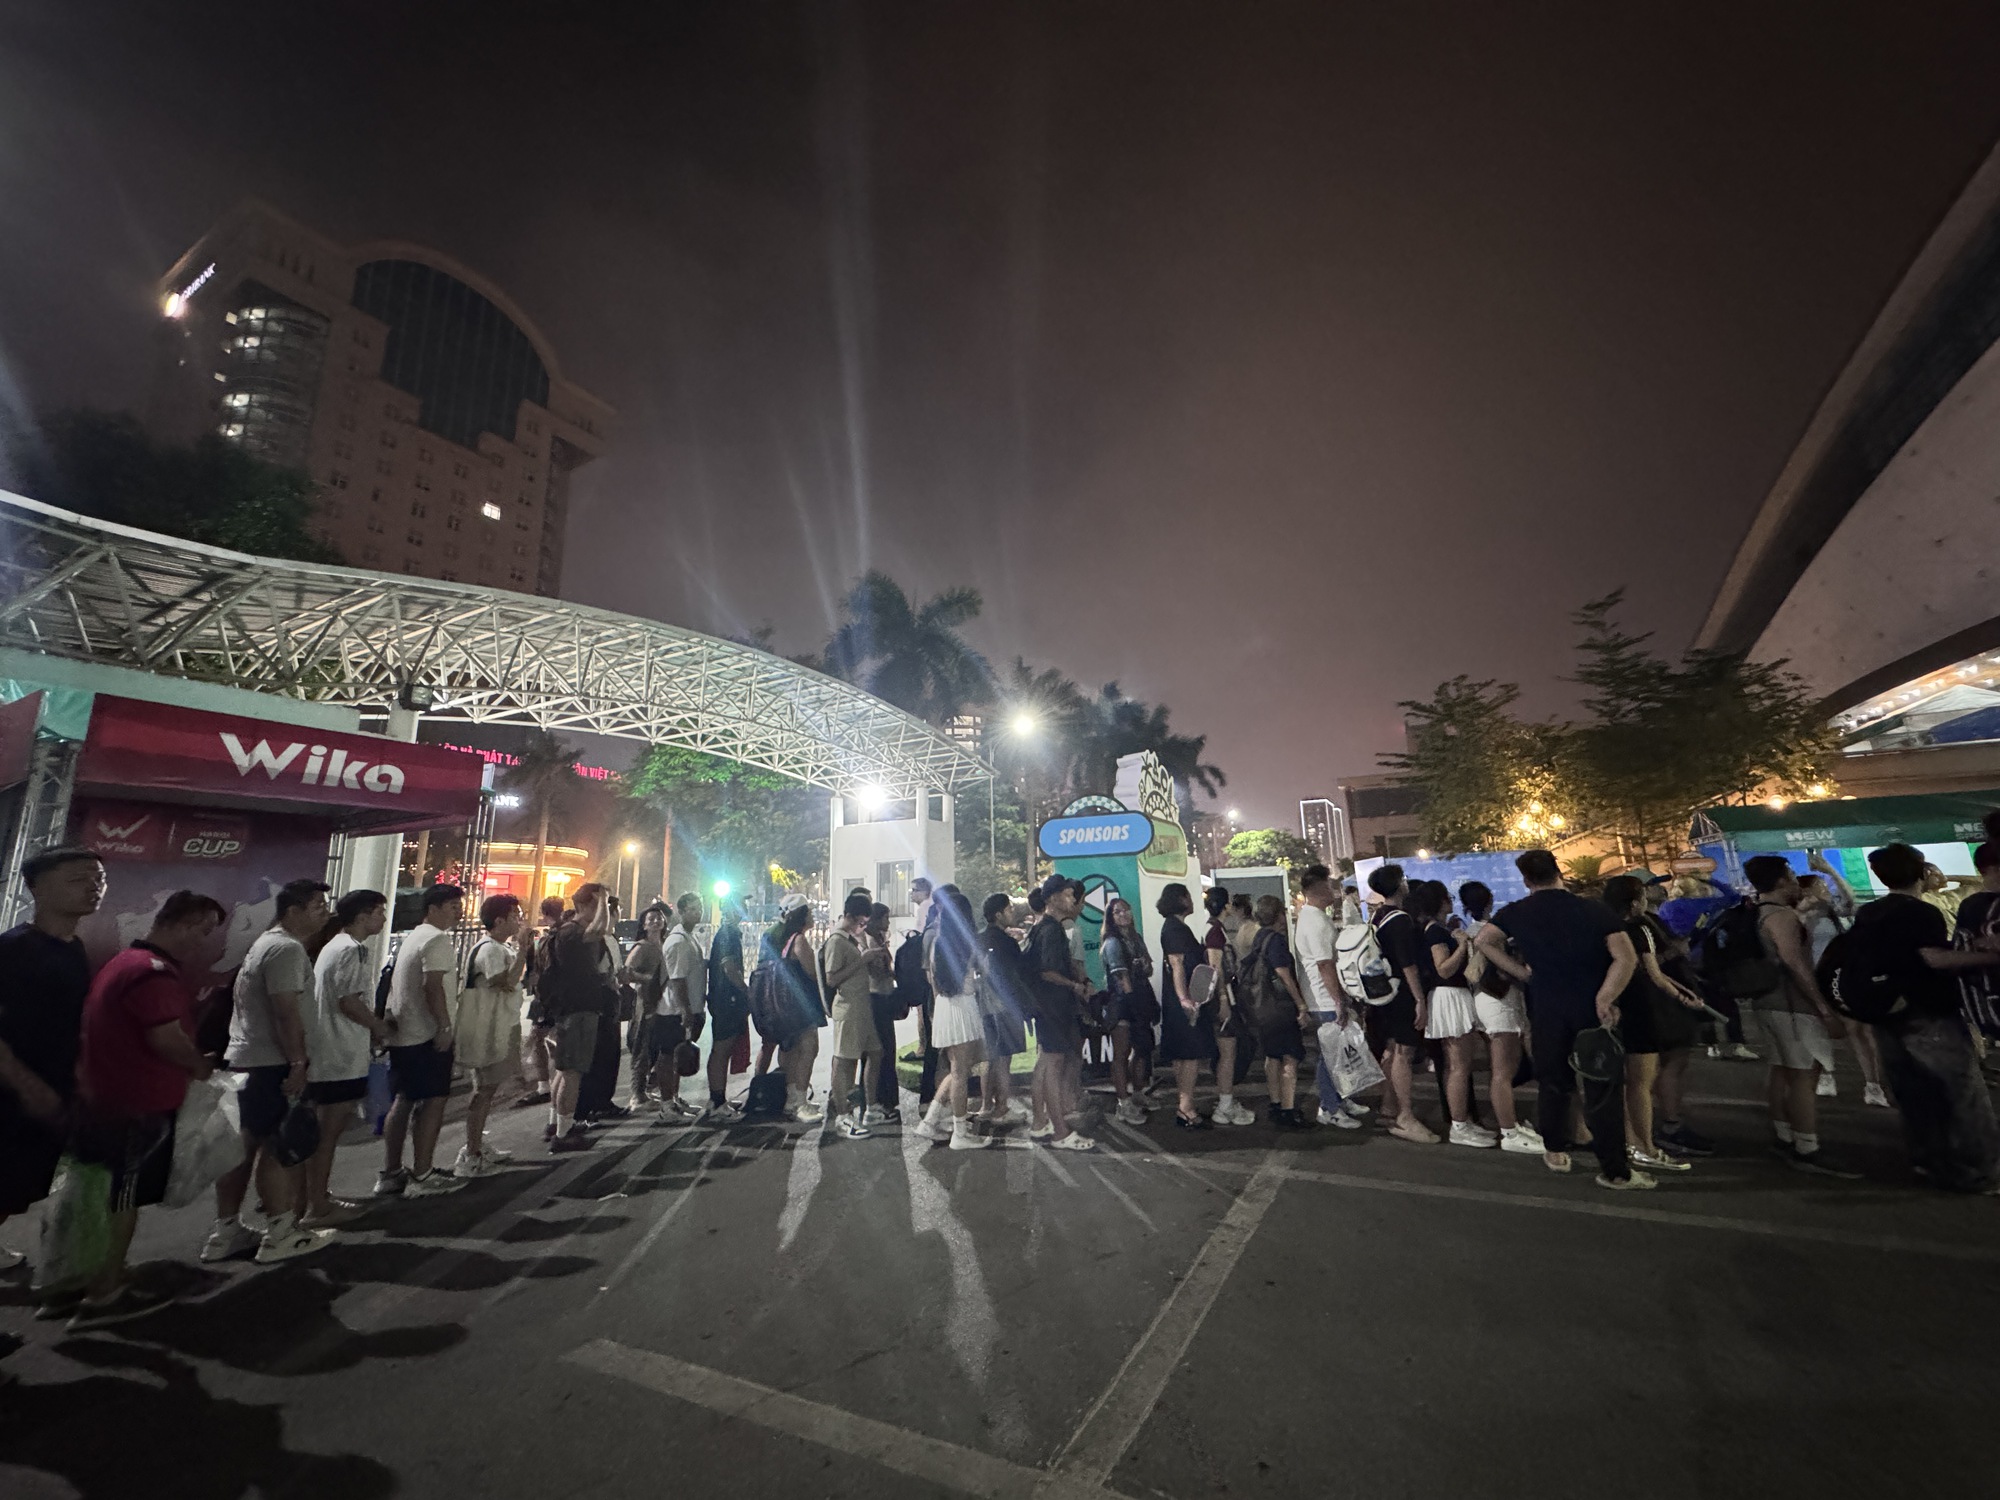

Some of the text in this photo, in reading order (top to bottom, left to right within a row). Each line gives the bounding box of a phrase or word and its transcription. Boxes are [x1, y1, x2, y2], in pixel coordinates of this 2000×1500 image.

[219, 732, 405, 794] Wika
[589, 766, 609, 780] VIỆT
[1059, 824, 1130, 845] SPONSORS
[1785, 830, 1834, 841] NEW
[1953, 821, 1986, 833] NE
[183, 838, 241, 858] CUP
[1831, 967, 1844, 1003] JOOLA
